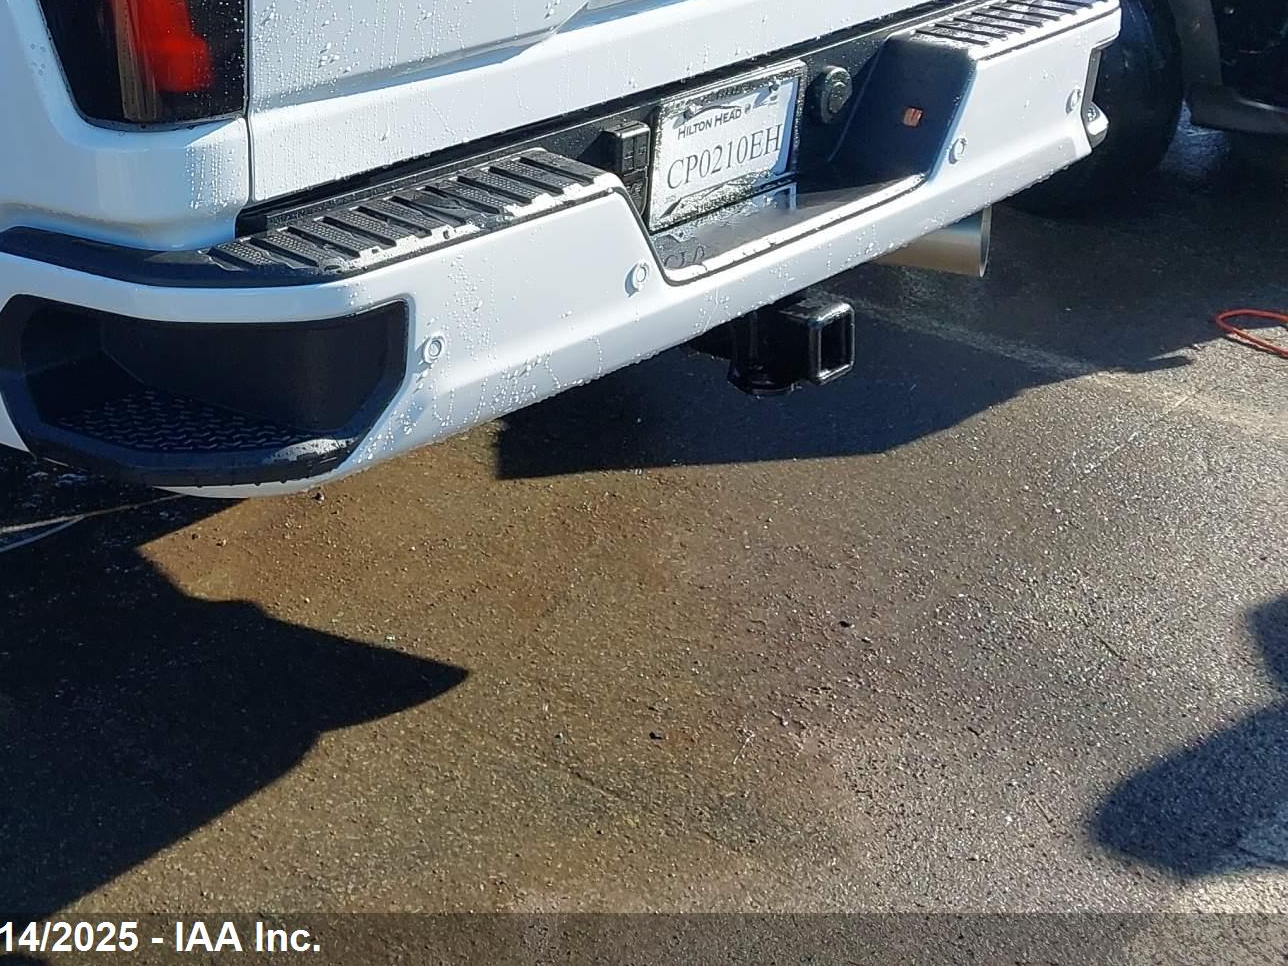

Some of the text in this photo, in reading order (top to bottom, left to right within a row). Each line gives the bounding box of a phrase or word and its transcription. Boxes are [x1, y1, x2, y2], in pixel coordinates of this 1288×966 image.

[677, 107, 743, 140] HILTON HEAD
[667, 123, 783, 189] CP0210EH
